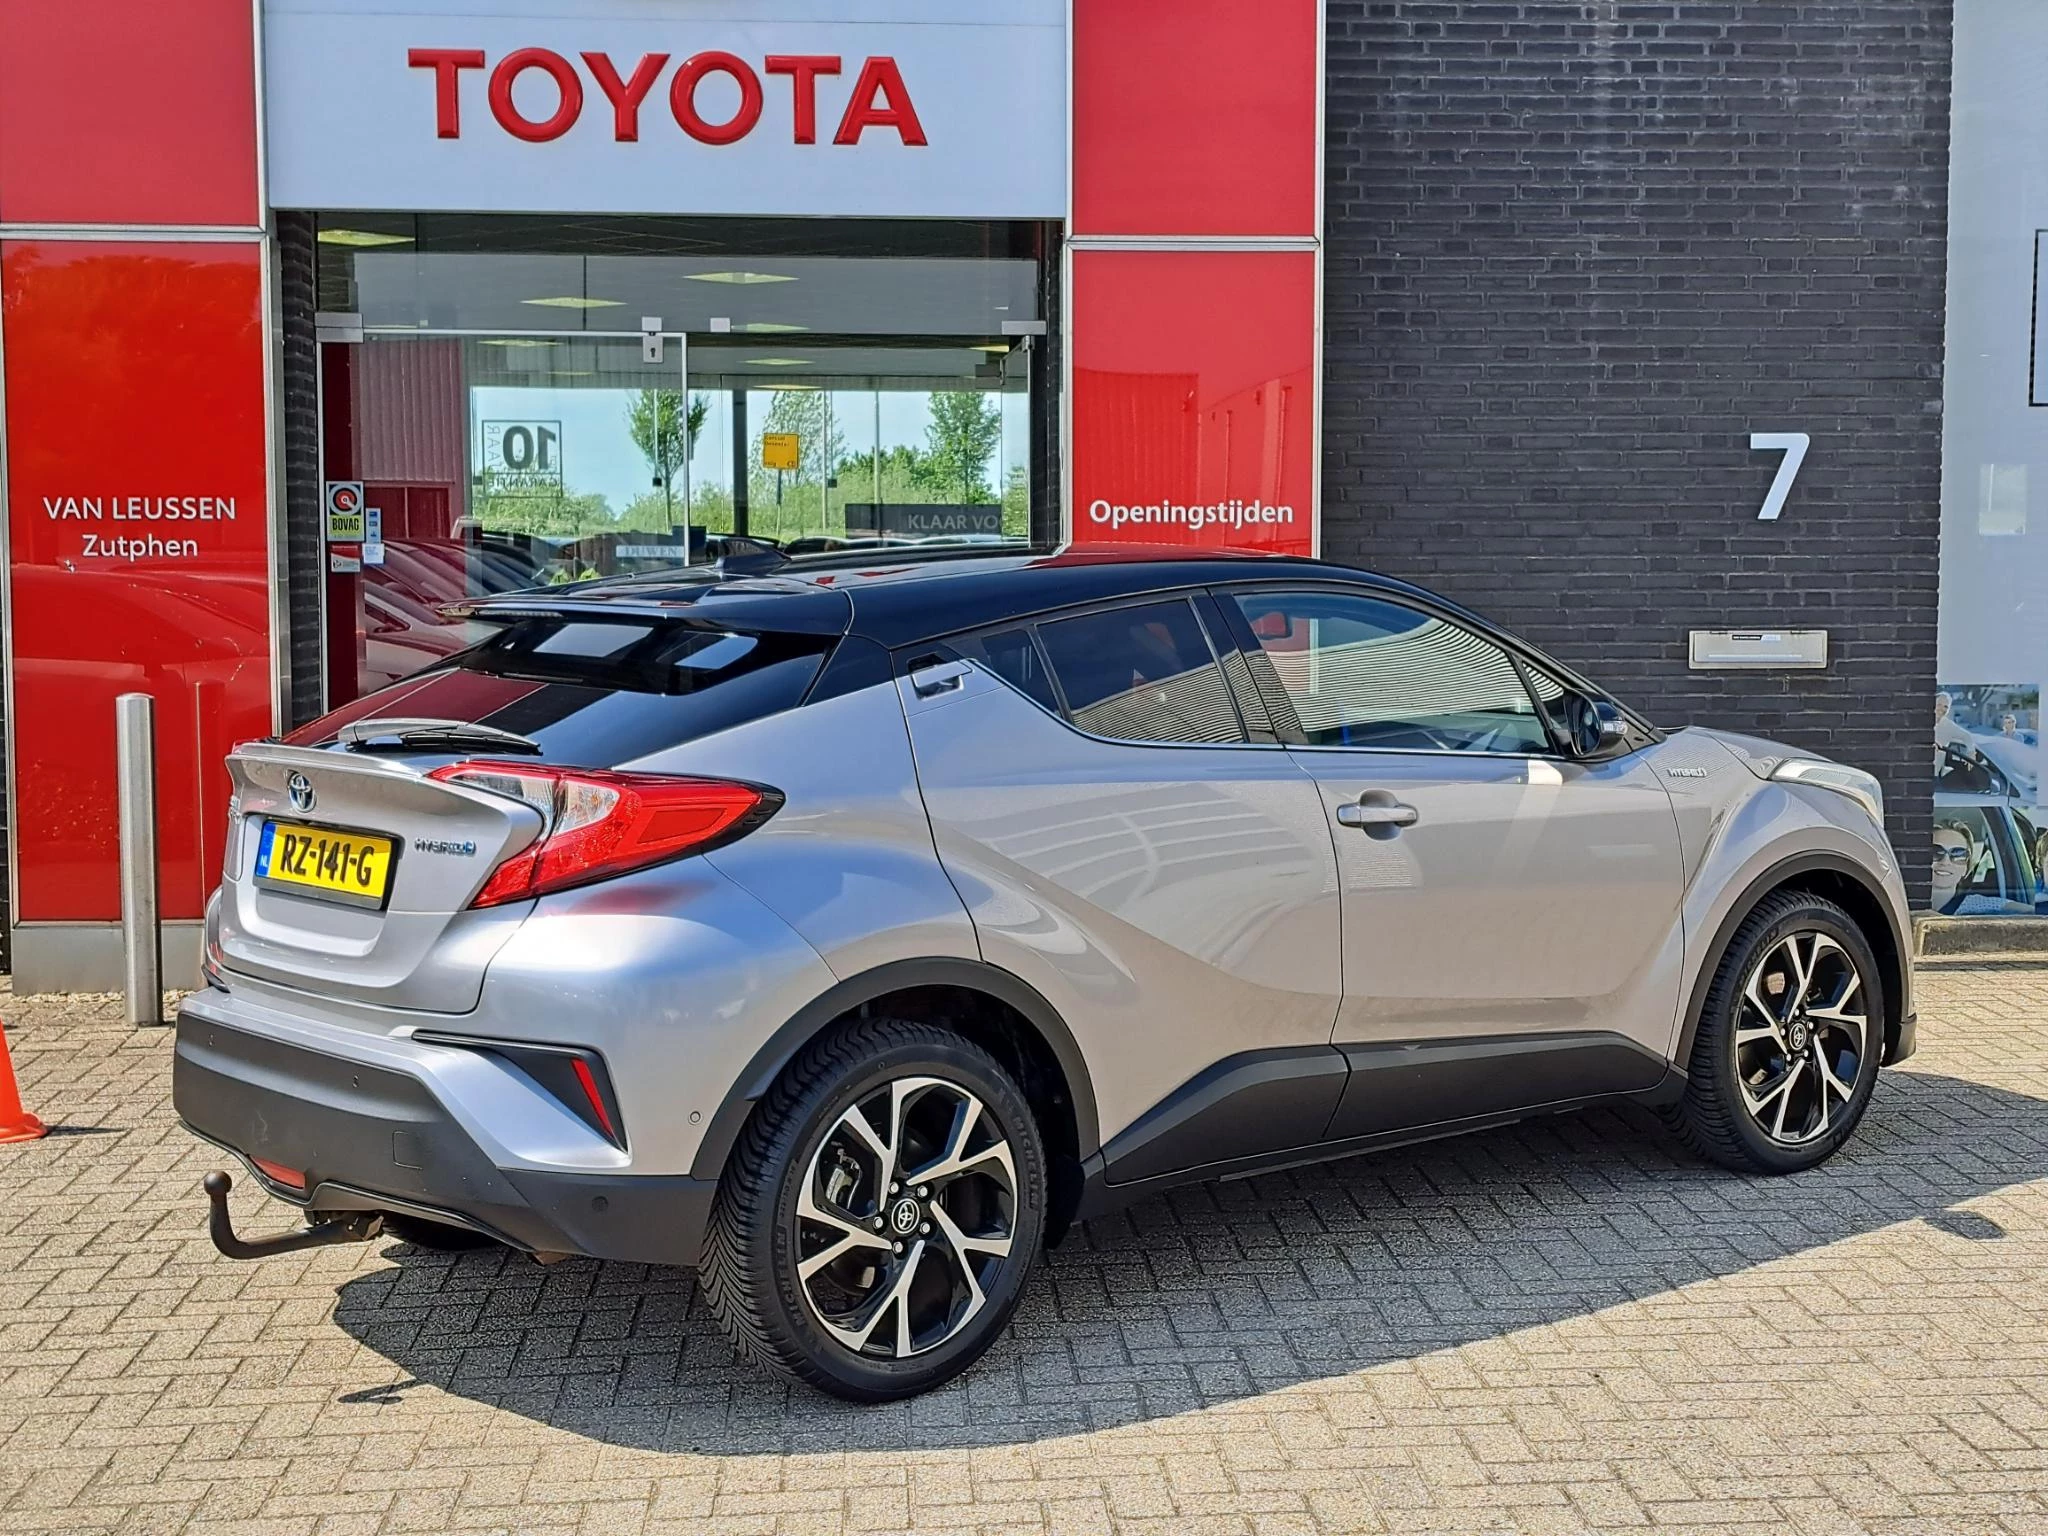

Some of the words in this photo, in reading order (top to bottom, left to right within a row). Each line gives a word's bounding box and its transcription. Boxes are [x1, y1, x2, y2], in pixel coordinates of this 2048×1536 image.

[407, 47, 928, 147] TOYOTA
[1750, 432, 1810, 520] 7
[43, 496, 102, 520] VAN
[112, 496, 236, 520] LEUSSEN
[908, 513, 968, 530] KLAAR
[972, 514, 1002, 530] VO
[1089, 499, 1294, 529] Openingstijden
[332, 517, 360, 531] BOVAG
[82, 533, 198, 562] Zutphen
[260, 854, 269, 868] NL
[280, 833, 375, 888] RZ-141-G
